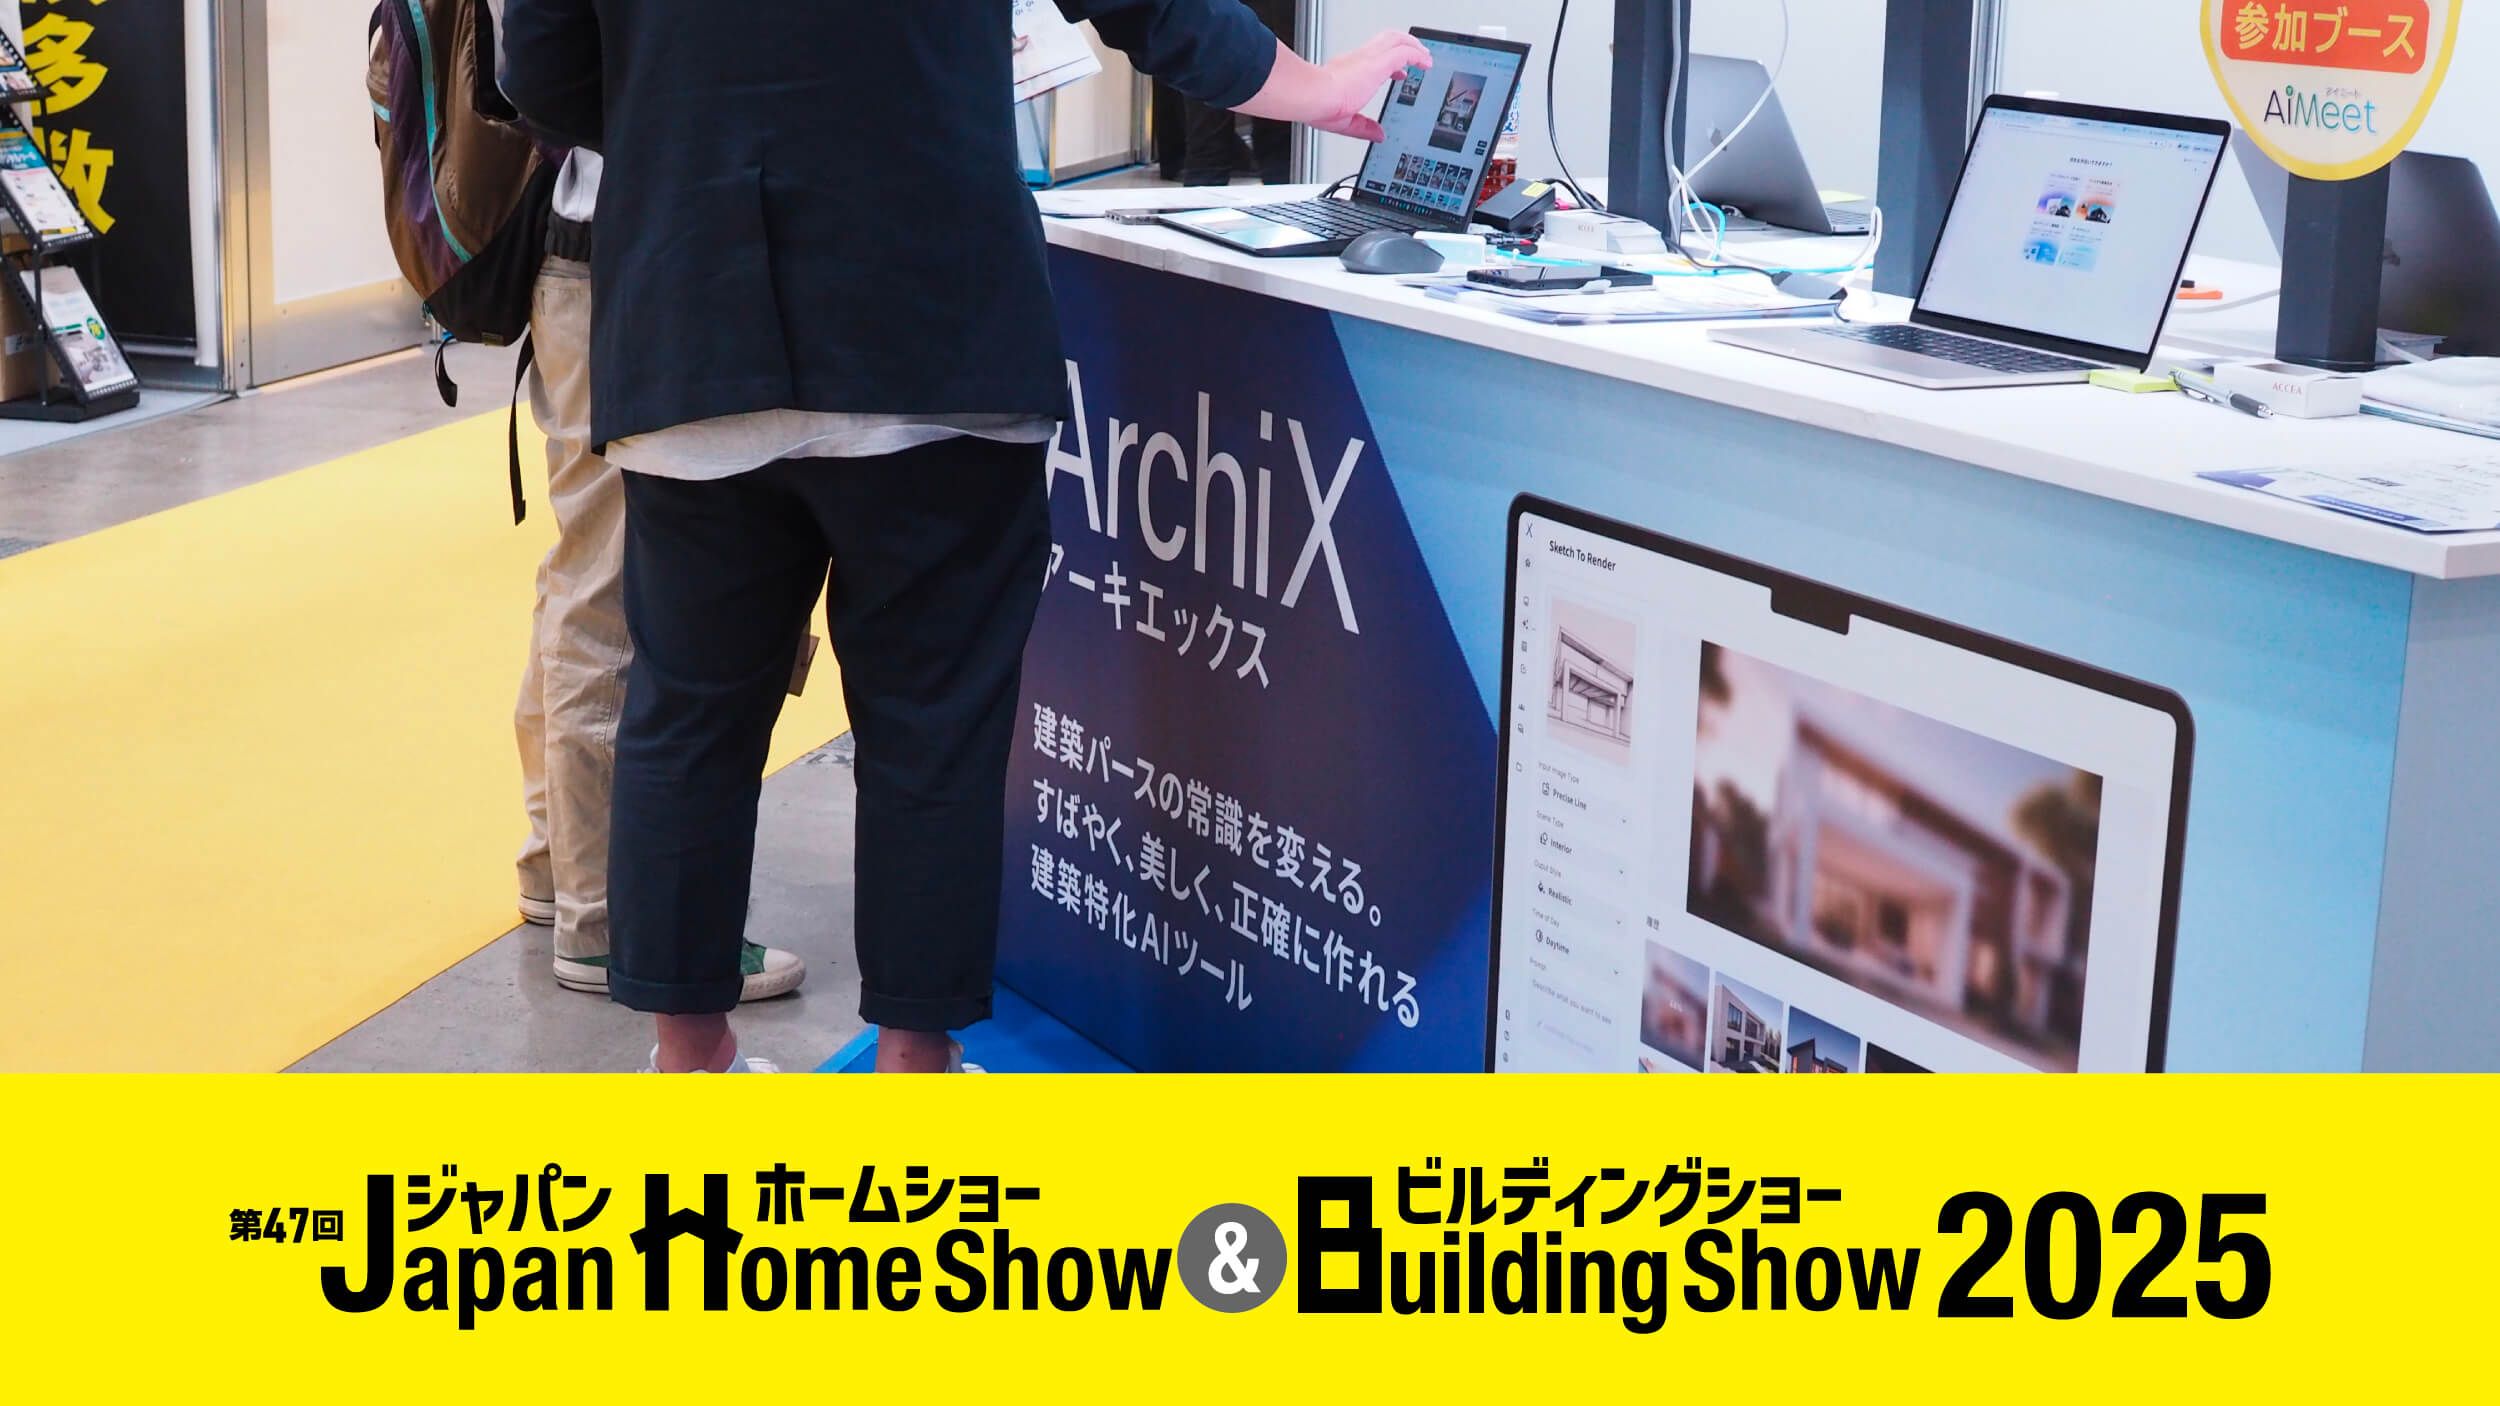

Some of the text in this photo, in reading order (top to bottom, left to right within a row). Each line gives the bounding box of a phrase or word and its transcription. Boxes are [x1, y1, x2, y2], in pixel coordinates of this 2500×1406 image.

[2234, 3, 2416, 59] 参加ブース
[20, 0, 116, 234] 多数
[2264, 85, 2377, 134] AiMeet
[1549, 540, 1617, 572] Sketch To Render
[1033, 702, 1382, 928] 建築パースの常識を変える。
[1552, 788, 1587, 810] Precise Line
[1550, 838, 1572, 855] Interior
[1033, 778, 1420, 1029] すばやく、美しく、正確に作れる
[1548, 887, 1573, 906] Realistic
[1031, 843, 1254, 1012] 建築特化AIツール
[1546, 936, 1570, 954] Daytime
